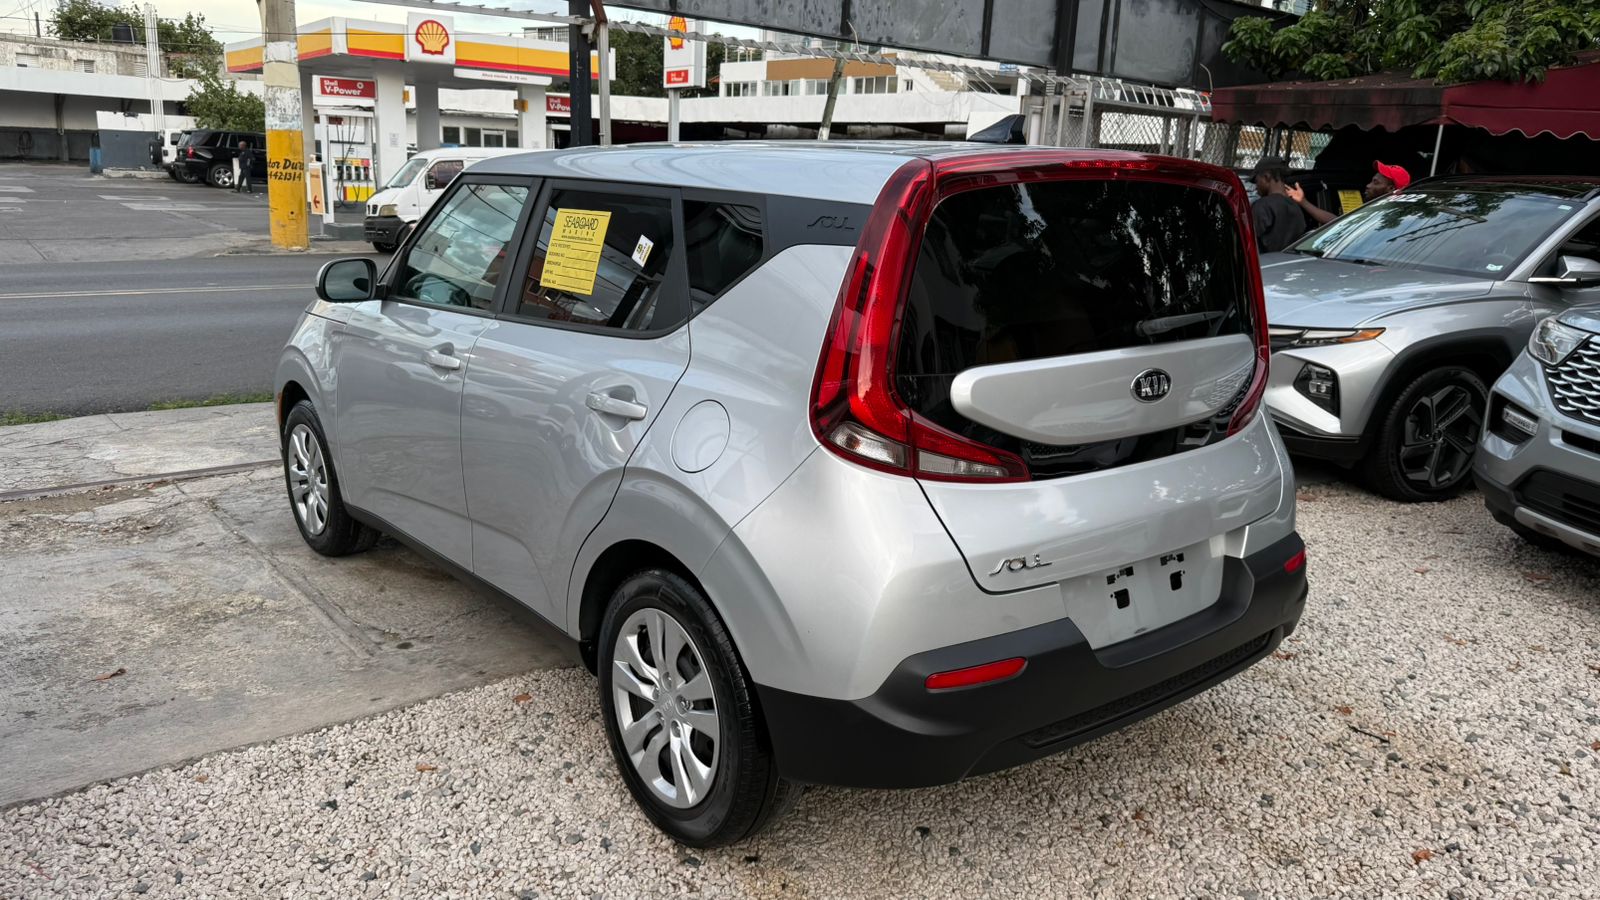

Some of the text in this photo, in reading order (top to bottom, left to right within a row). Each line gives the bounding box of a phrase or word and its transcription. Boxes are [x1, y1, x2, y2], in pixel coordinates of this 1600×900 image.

[324, 86, 362, 96] V-Power
[550, 103, 571, 111] V-Pow
[563, 215, 599, 231] SEABOARD
[1140, 374, 1168, 397] KIA
